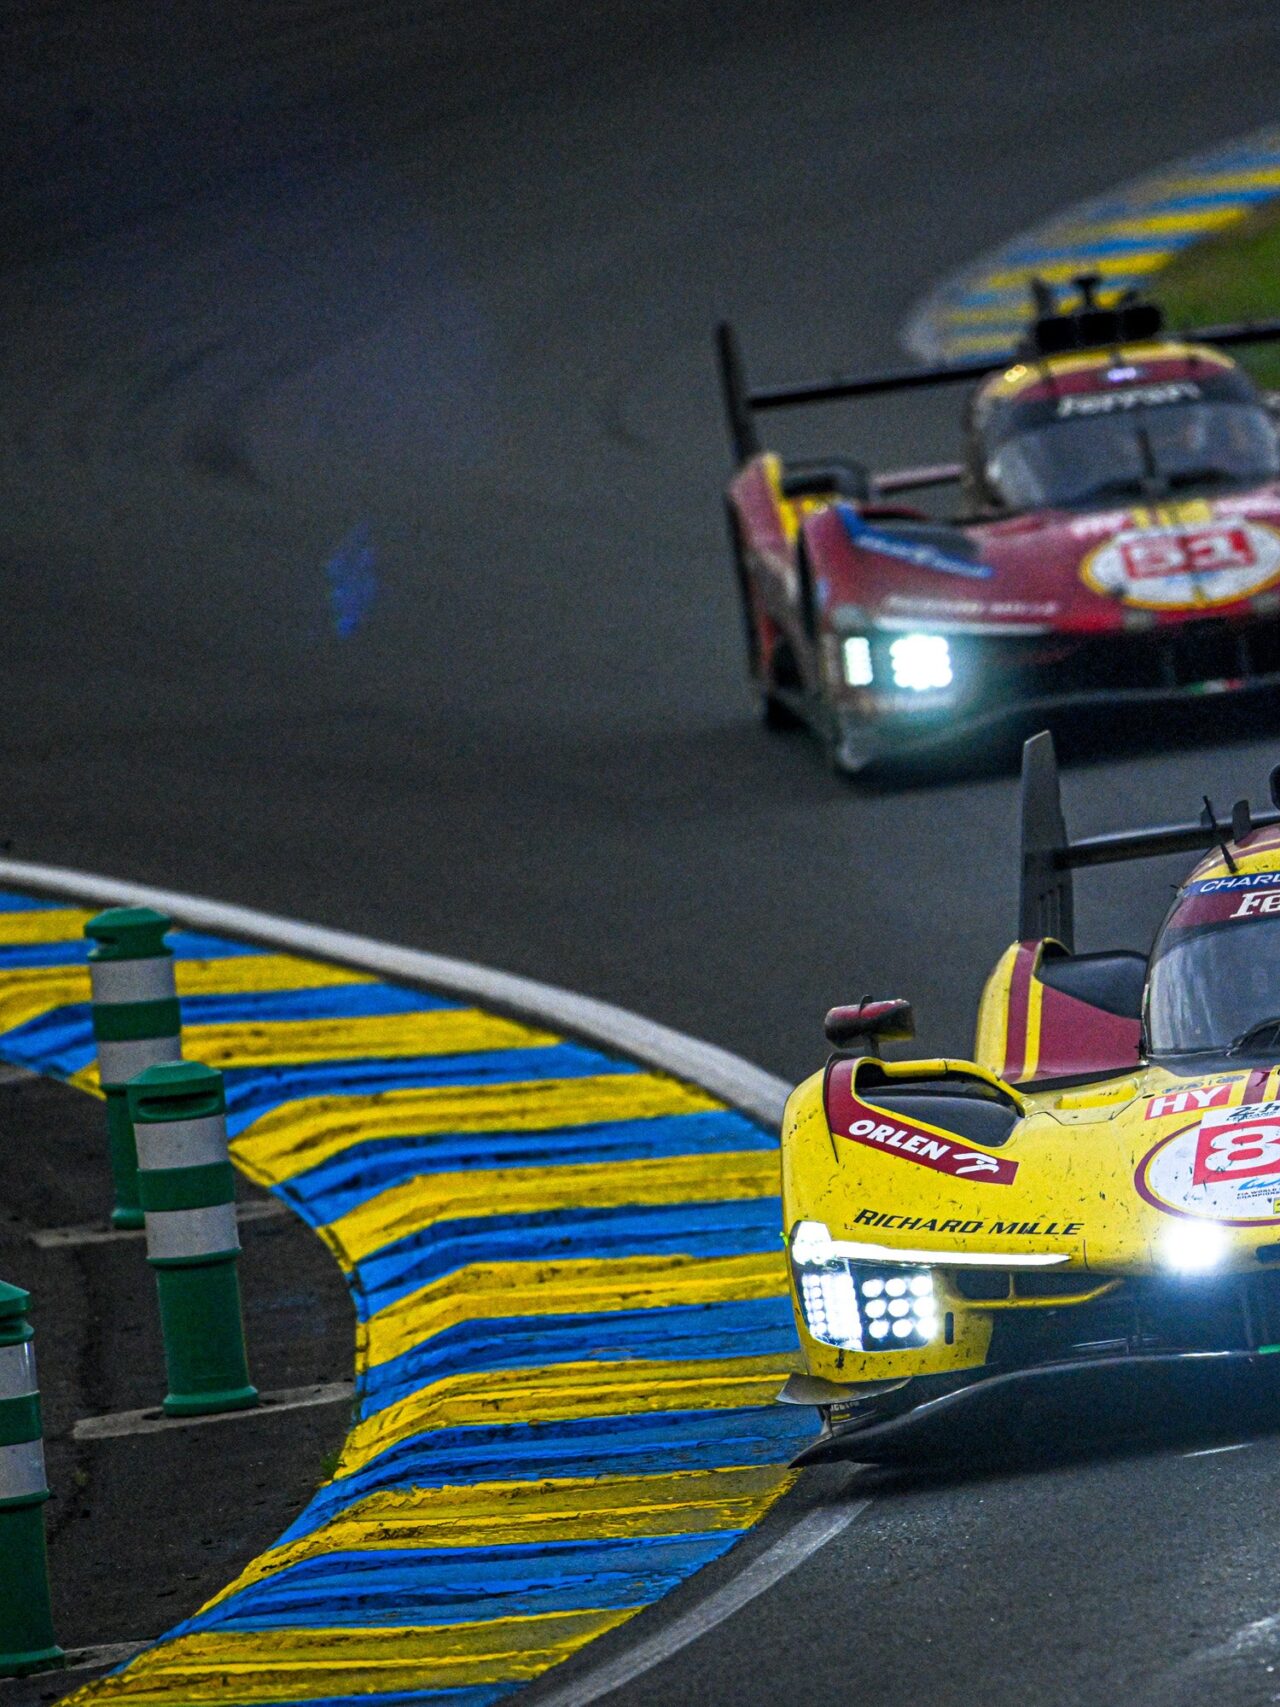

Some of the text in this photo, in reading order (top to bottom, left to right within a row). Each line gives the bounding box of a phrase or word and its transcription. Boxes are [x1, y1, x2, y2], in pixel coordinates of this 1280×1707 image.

[1150, 1084, 1228, 1118] HY
[848, 1119, 951, 1161] ORLEN
[853, 1209, 1085, 1236] RICHARD MILLE
